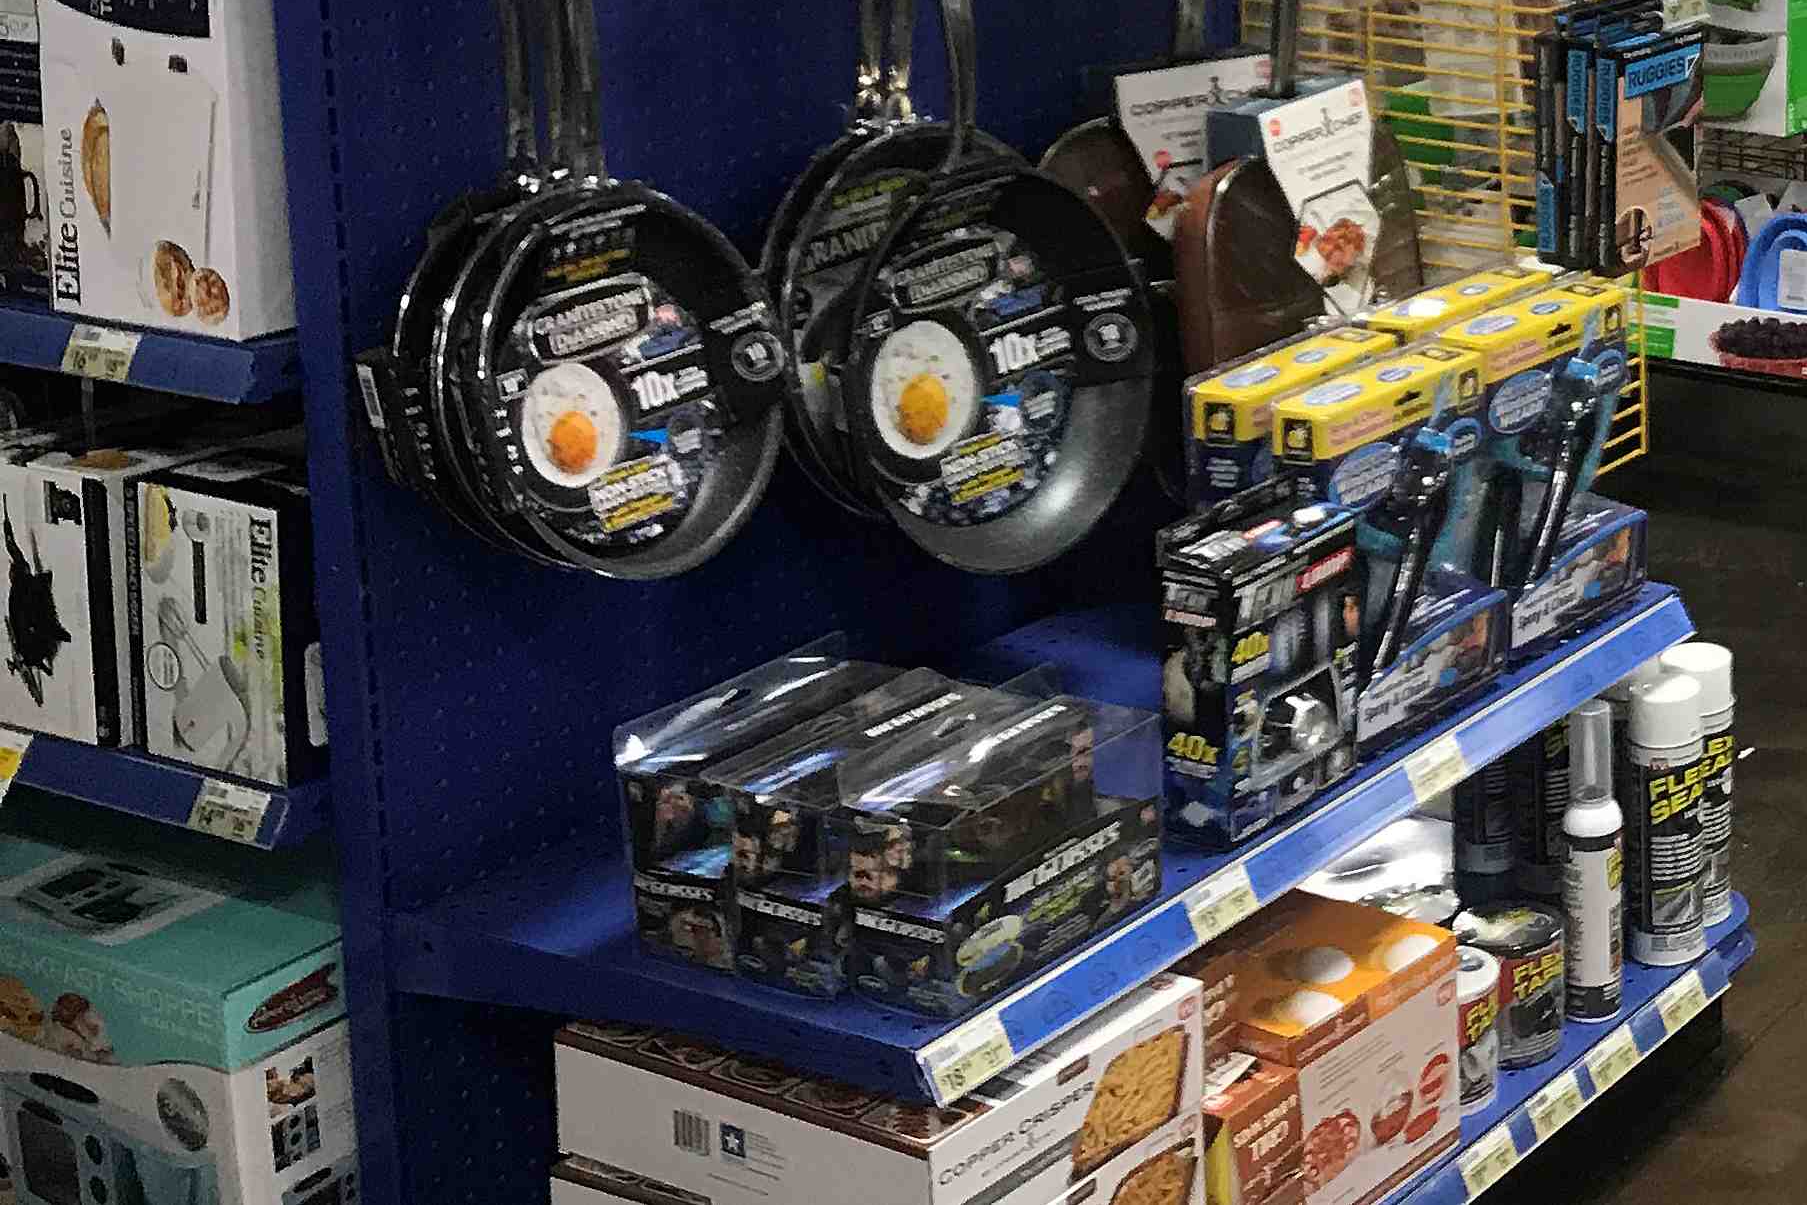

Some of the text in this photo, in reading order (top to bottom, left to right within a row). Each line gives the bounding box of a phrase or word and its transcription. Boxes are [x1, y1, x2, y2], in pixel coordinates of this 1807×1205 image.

[1628, 57, 1686, 87] RUGGIES
[55, 127, 82, 306] Elite Cuisine
[248, 517, 272, 586] Elite
[1650, 768, 1701, 799] FLE
[1650, 784, 1703, 826] SEA
[938, 1131, 1016, 1186] COPPER
